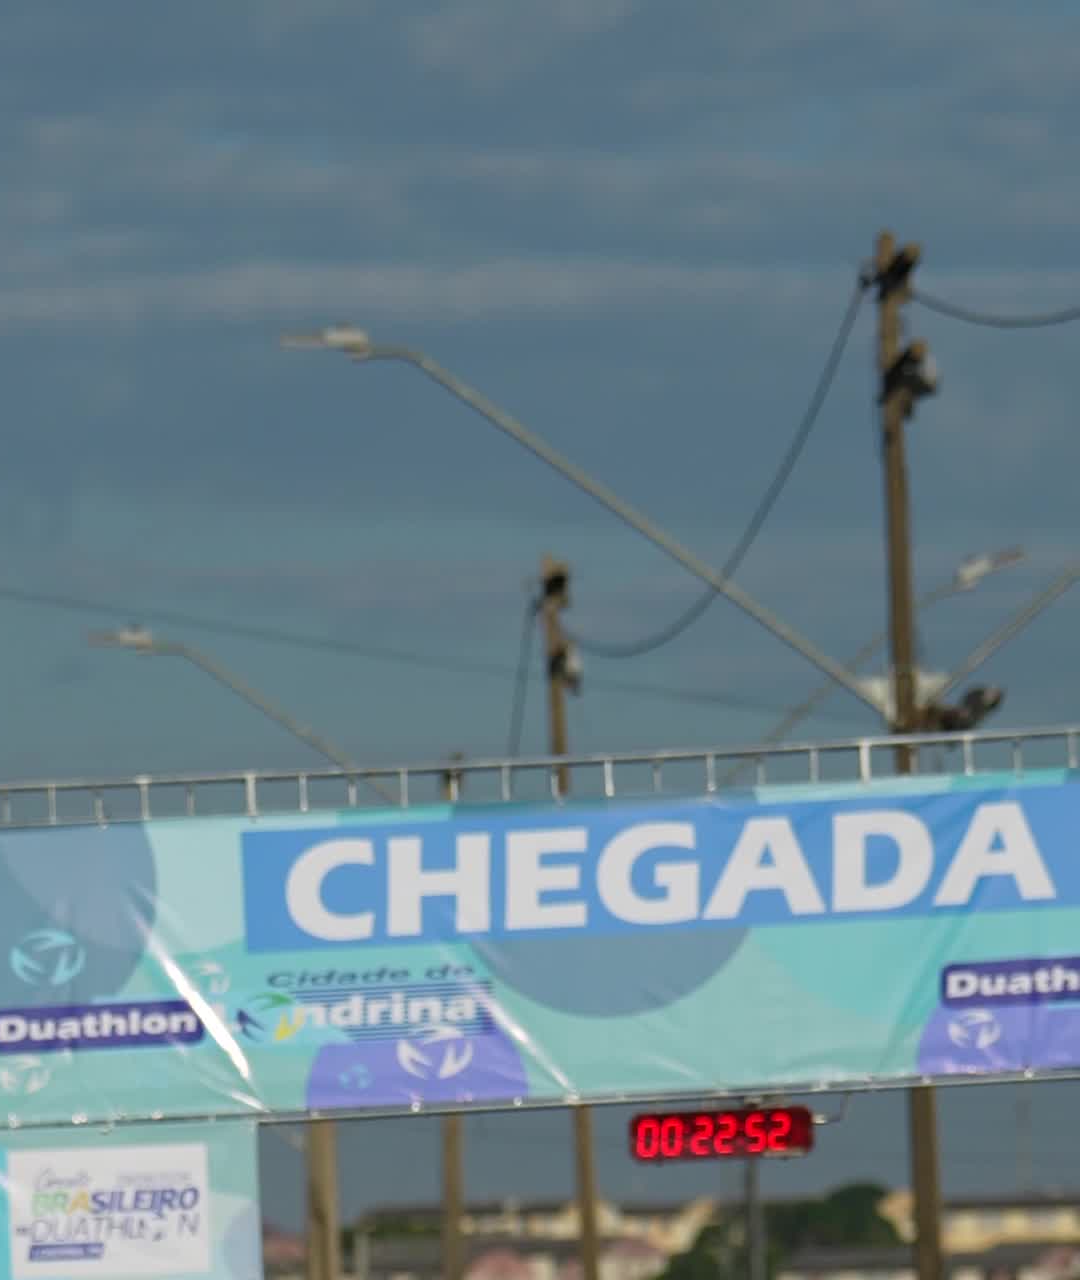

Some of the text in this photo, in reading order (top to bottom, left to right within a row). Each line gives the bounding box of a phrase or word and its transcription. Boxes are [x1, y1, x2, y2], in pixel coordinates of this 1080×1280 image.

[285, 799, 1057, 942] CHEGADA
[266, 966, 412, 989] Cidade
[946, 972, 1080, 999] Duath
[31, 1187, 200, 1217] BRASILEIRO
